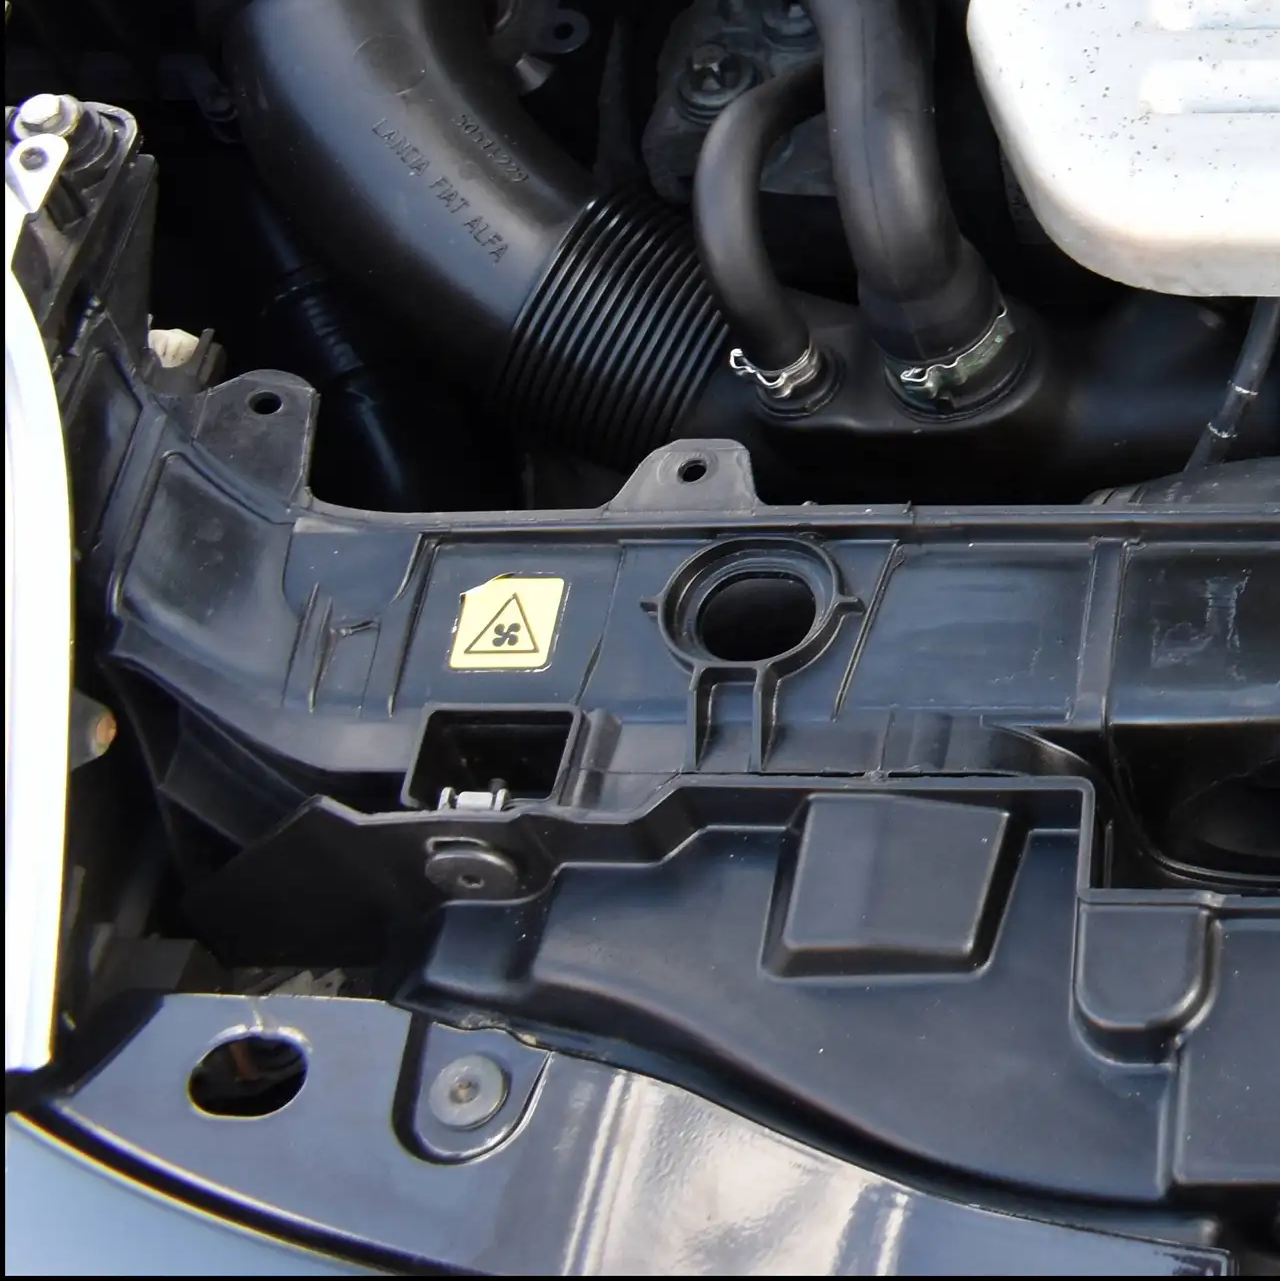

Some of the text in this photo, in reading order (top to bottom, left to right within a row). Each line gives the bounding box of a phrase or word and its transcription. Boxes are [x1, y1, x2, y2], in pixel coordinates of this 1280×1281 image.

[371, 118, 510, 264] LANCIA FIAT ALFA
